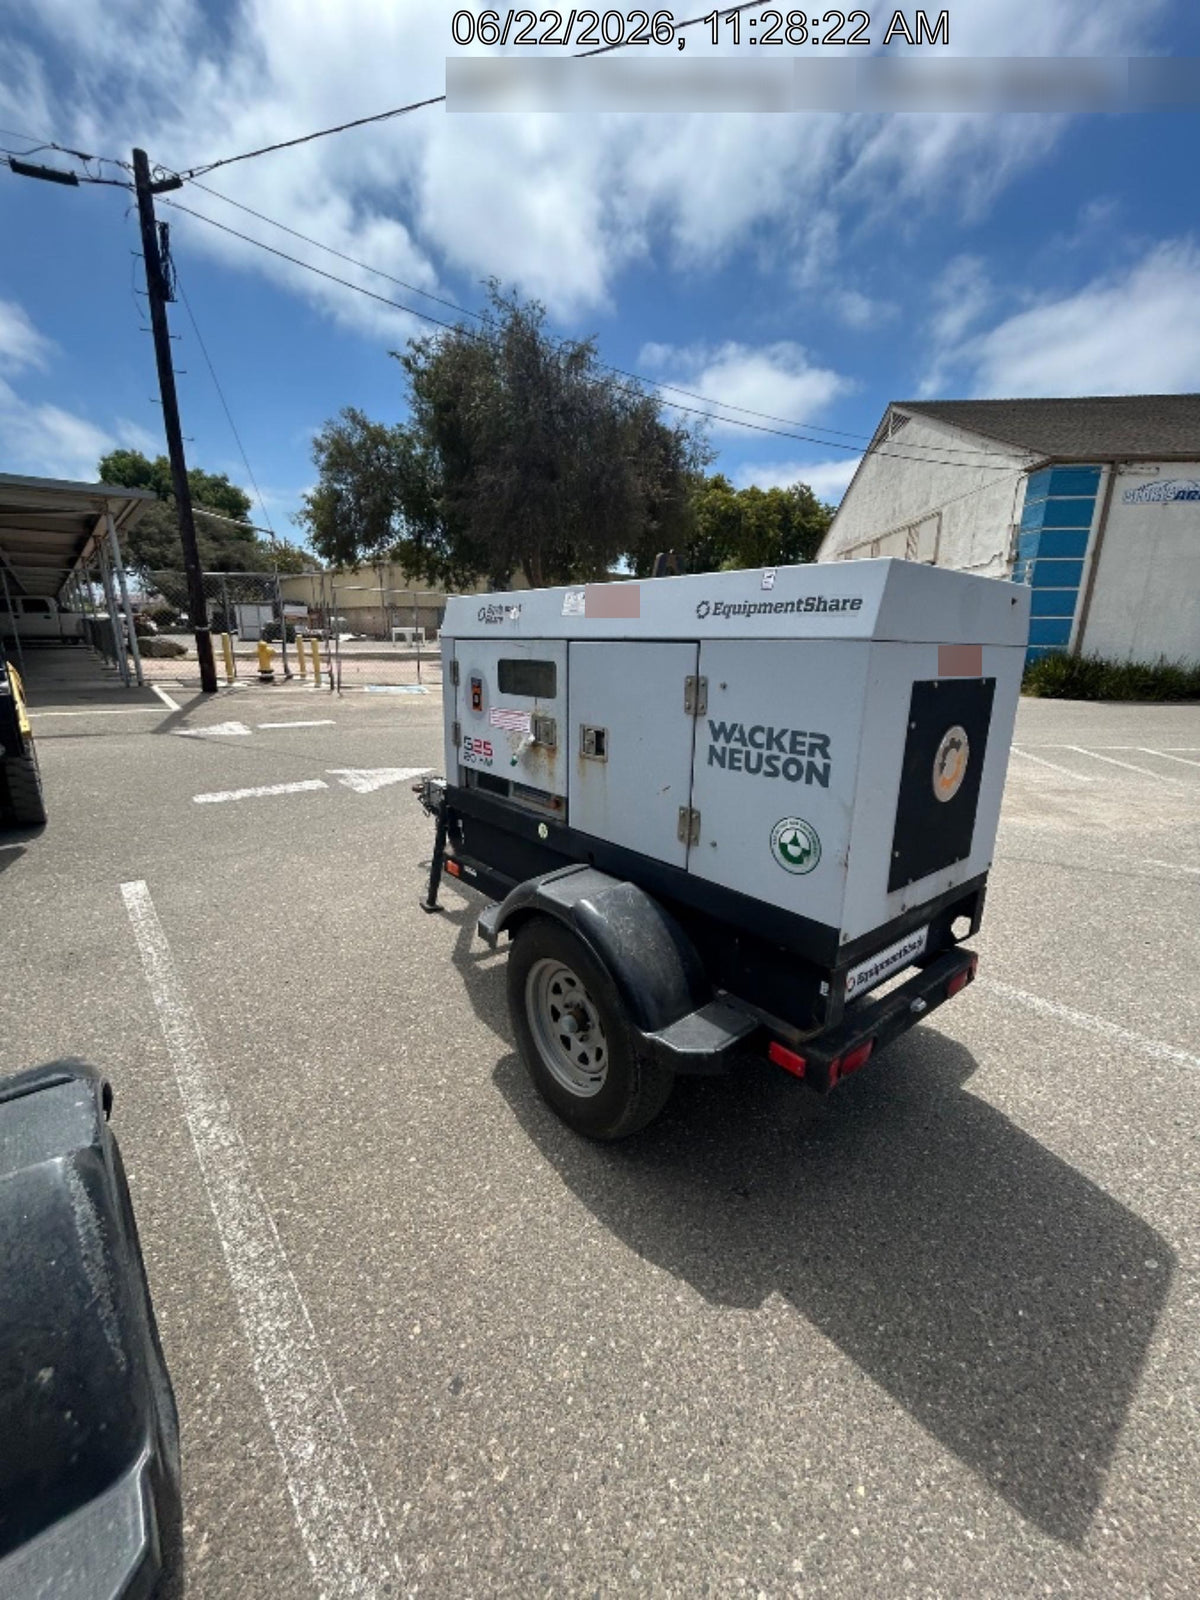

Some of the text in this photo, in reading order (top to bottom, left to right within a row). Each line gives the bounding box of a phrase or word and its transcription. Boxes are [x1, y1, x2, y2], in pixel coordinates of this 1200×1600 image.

[712, 595, 863, 619] EquipmentShare
[708, 719, 832, 761] WACKER
[707, 744, 831, 788] NEUSON
